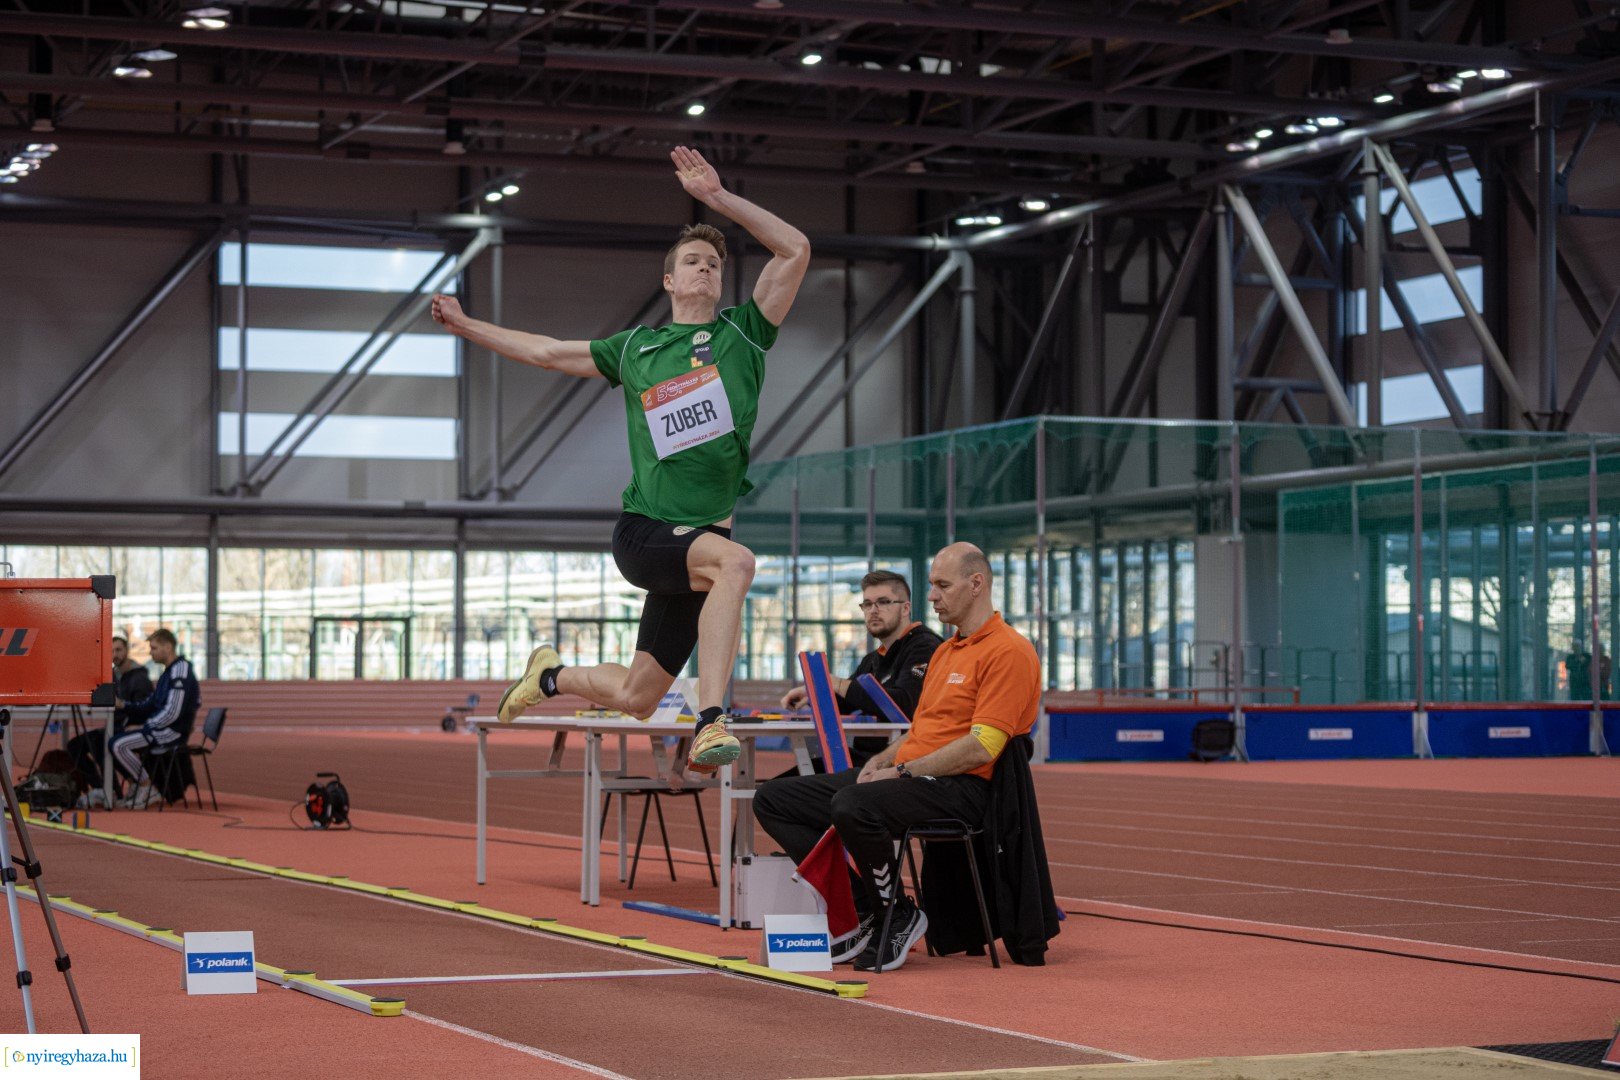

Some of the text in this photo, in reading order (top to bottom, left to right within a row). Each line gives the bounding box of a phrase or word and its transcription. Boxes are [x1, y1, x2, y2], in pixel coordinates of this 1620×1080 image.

[661, 399, 718, 437] ZUBER
[786, 938, 824, 949] polanik
[206, 957, 249, 969] polanik
